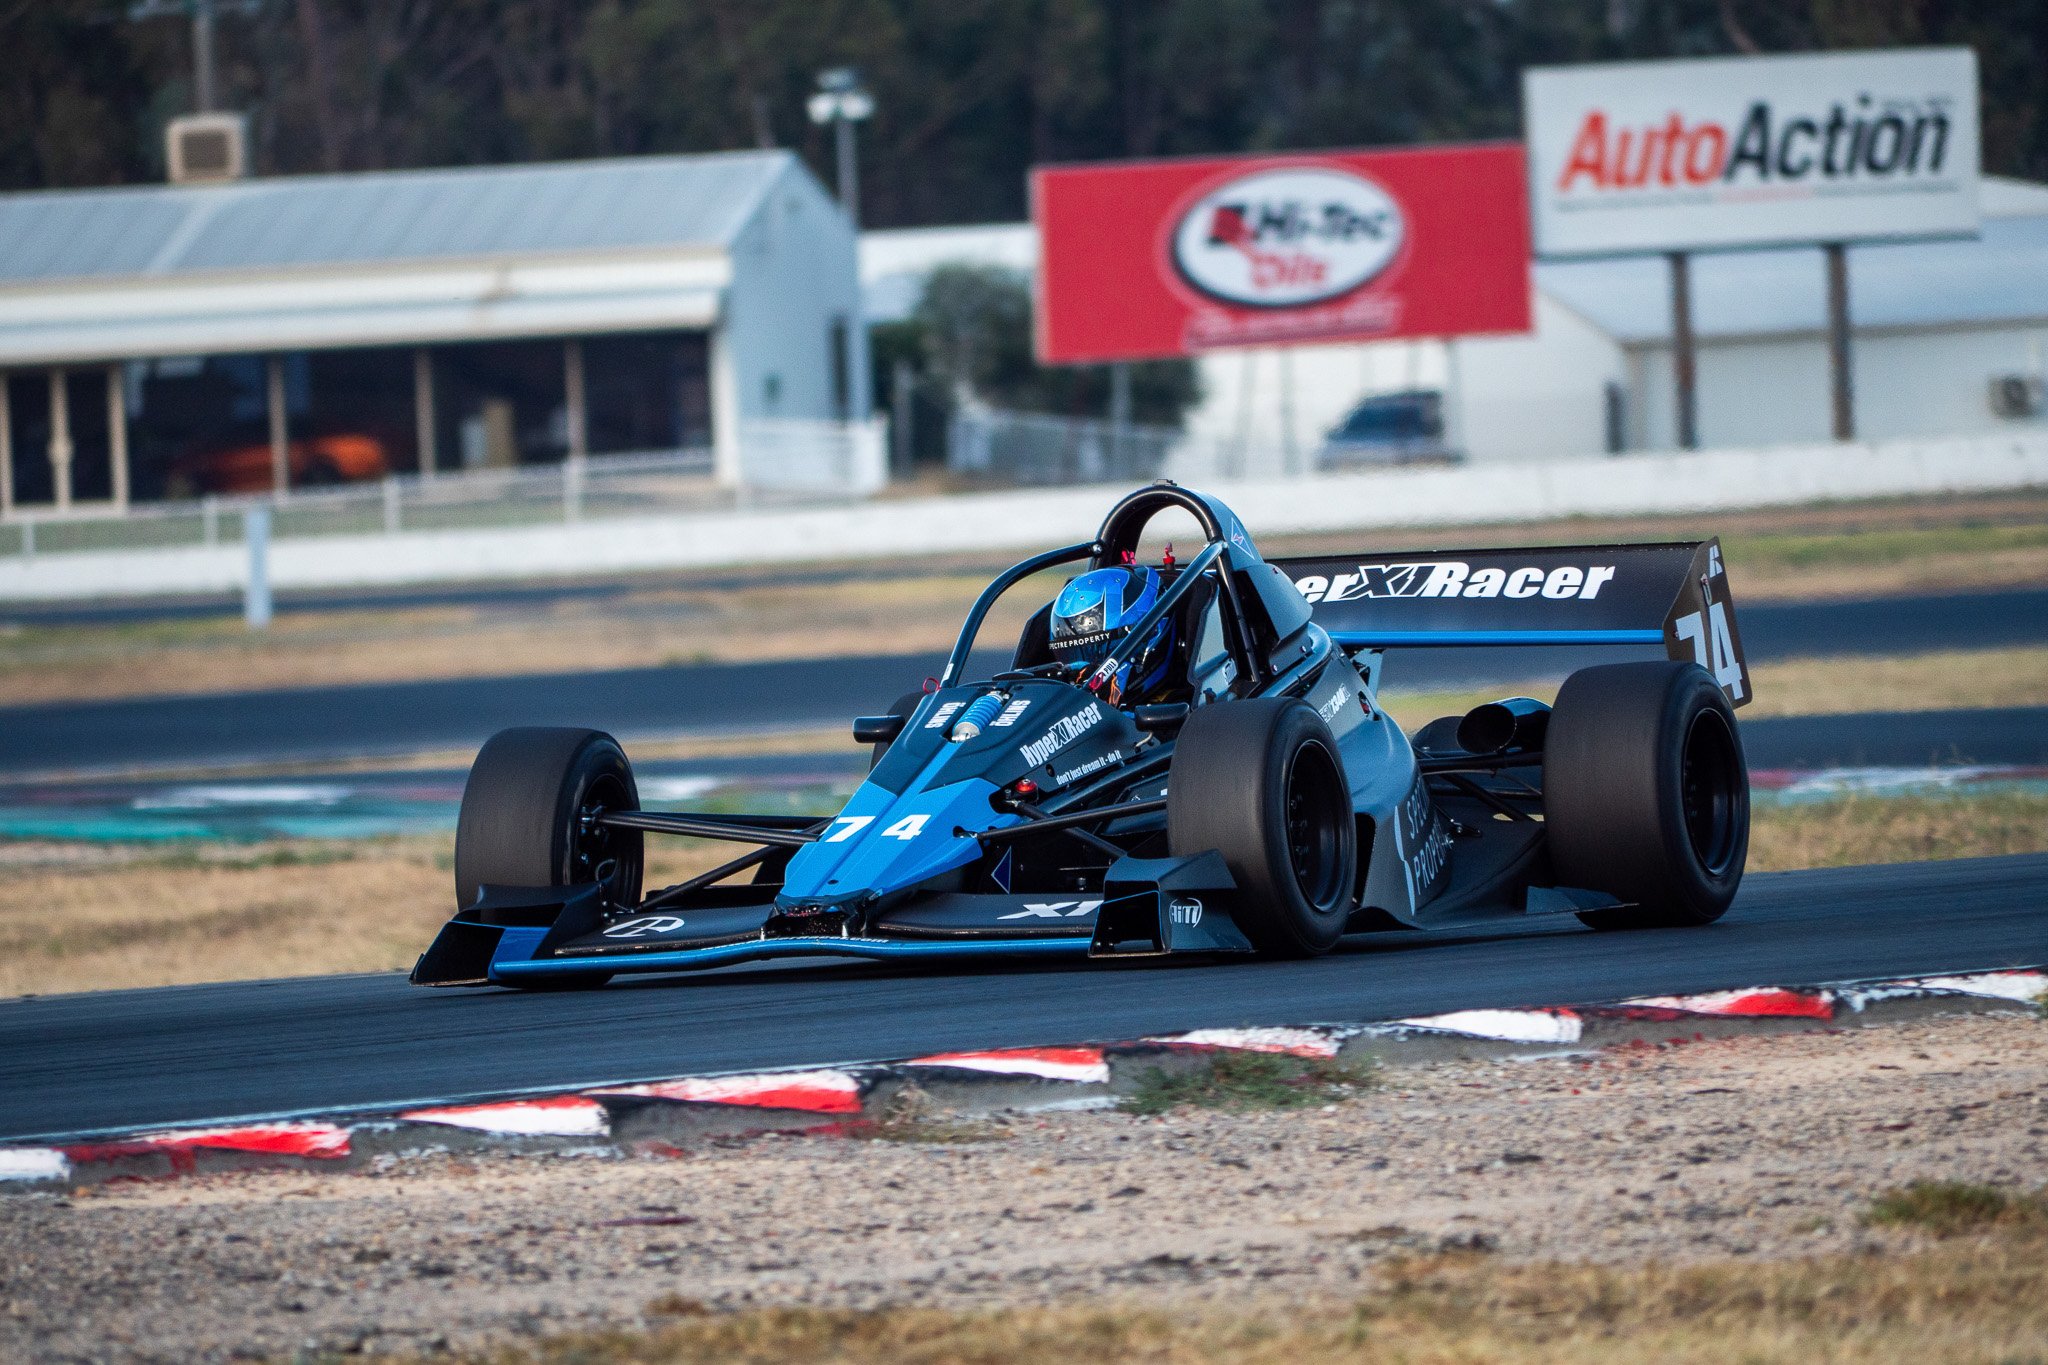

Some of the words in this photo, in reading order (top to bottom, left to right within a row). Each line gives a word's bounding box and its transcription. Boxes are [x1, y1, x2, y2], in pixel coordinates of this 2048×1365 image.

[1257, 201, 1389, 243] Hi-Tec
[1068, 632, 1111, 647] PROPERTY
[1676, 602, 1744, 700] 74
[1056, 767, 1073, 785] don't
[1069, 766, 1084, 780] just
[1081, 757, 1102, 773] dream
[1107, 752, 1116, 763] do
[1114, 750, 1122, 760] it
